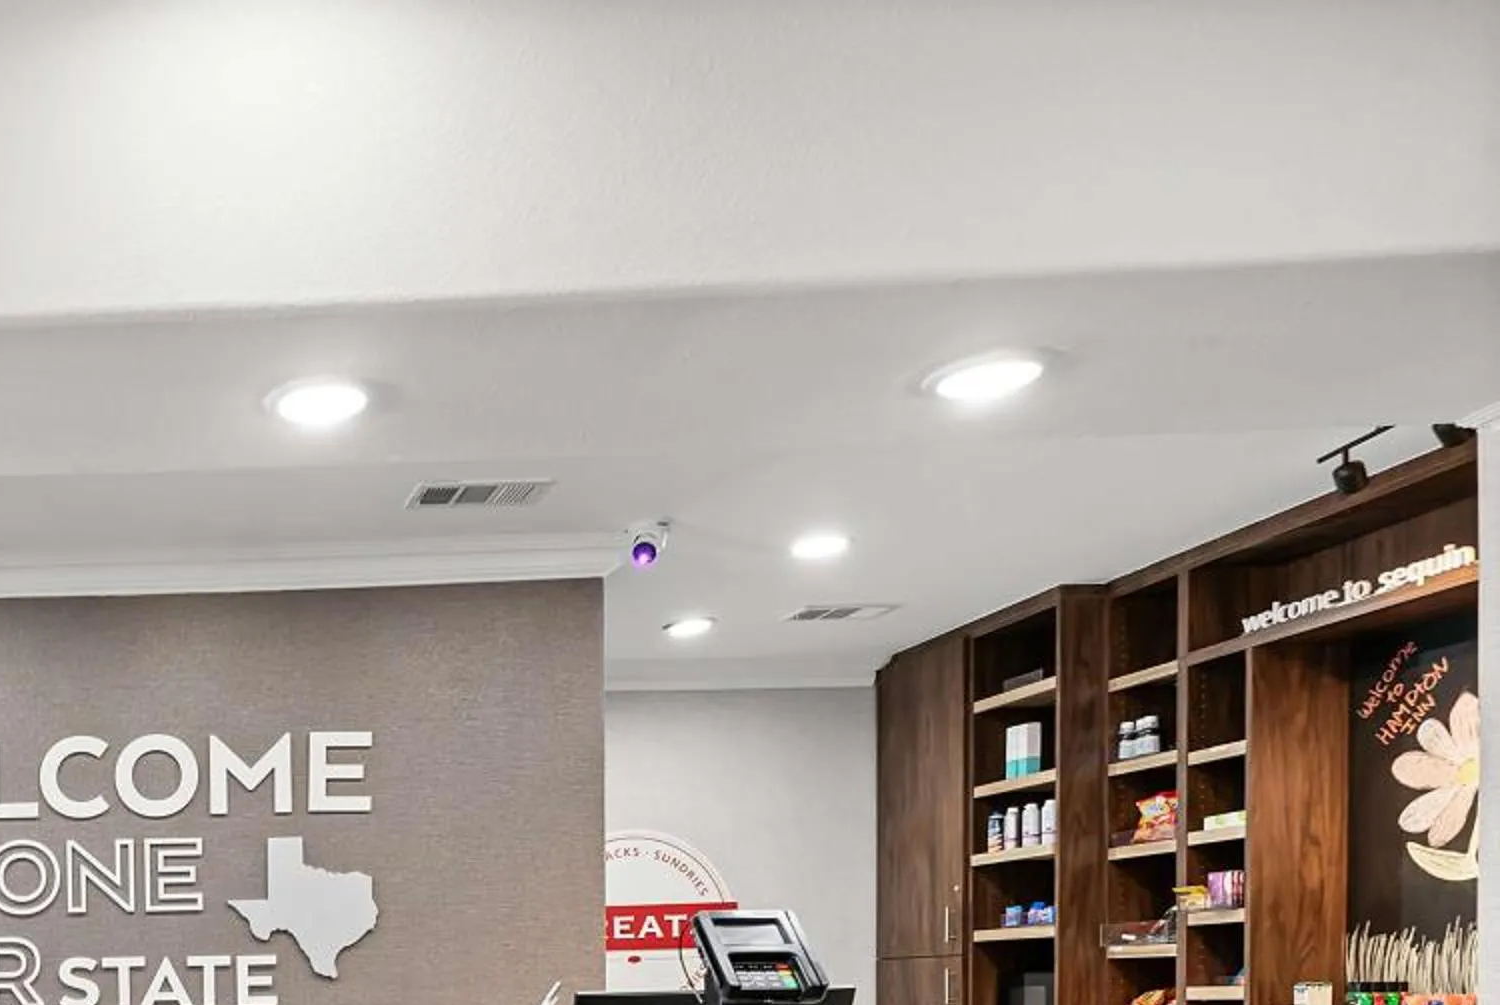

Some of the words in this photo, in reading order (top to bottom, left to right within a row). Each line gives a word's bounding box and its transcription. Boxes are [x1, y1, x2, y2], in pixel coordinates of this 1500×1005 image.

[1241, 588, 1340, 633] welcome
[1341, 579, 1372, 604] to
[1400, 694, 1436, 735] INN
[653, 849, 709, 897] SUNDRIES
[605, 913, 693, 940] EAT
